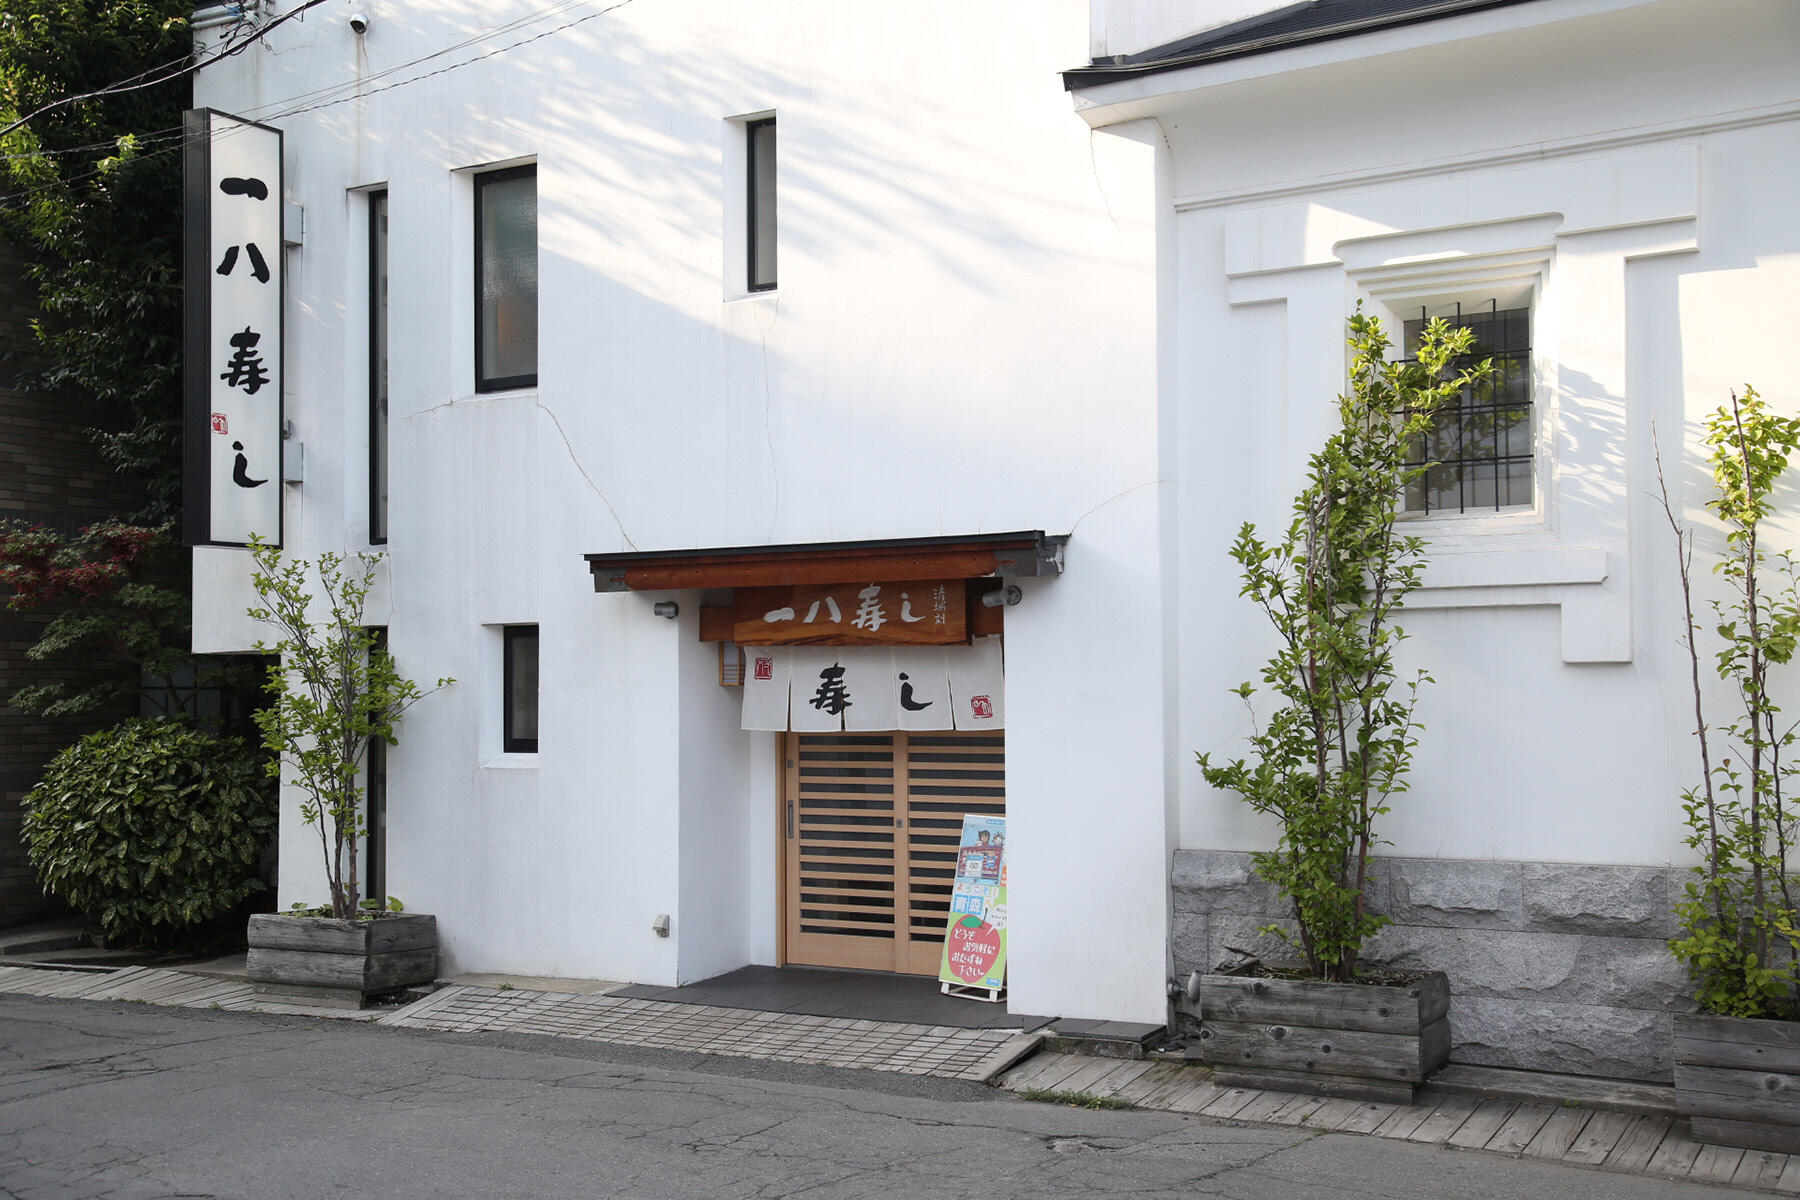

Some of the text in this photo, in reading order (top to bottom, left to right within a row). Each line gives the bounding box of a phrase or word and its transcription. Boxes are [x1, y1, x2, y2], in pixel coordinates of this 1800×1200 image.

[216, 176, 271, 488] 一八寿し
[763, 582, 926, 632] 一八寿し
[809, 662, 933, 715] 寿し
